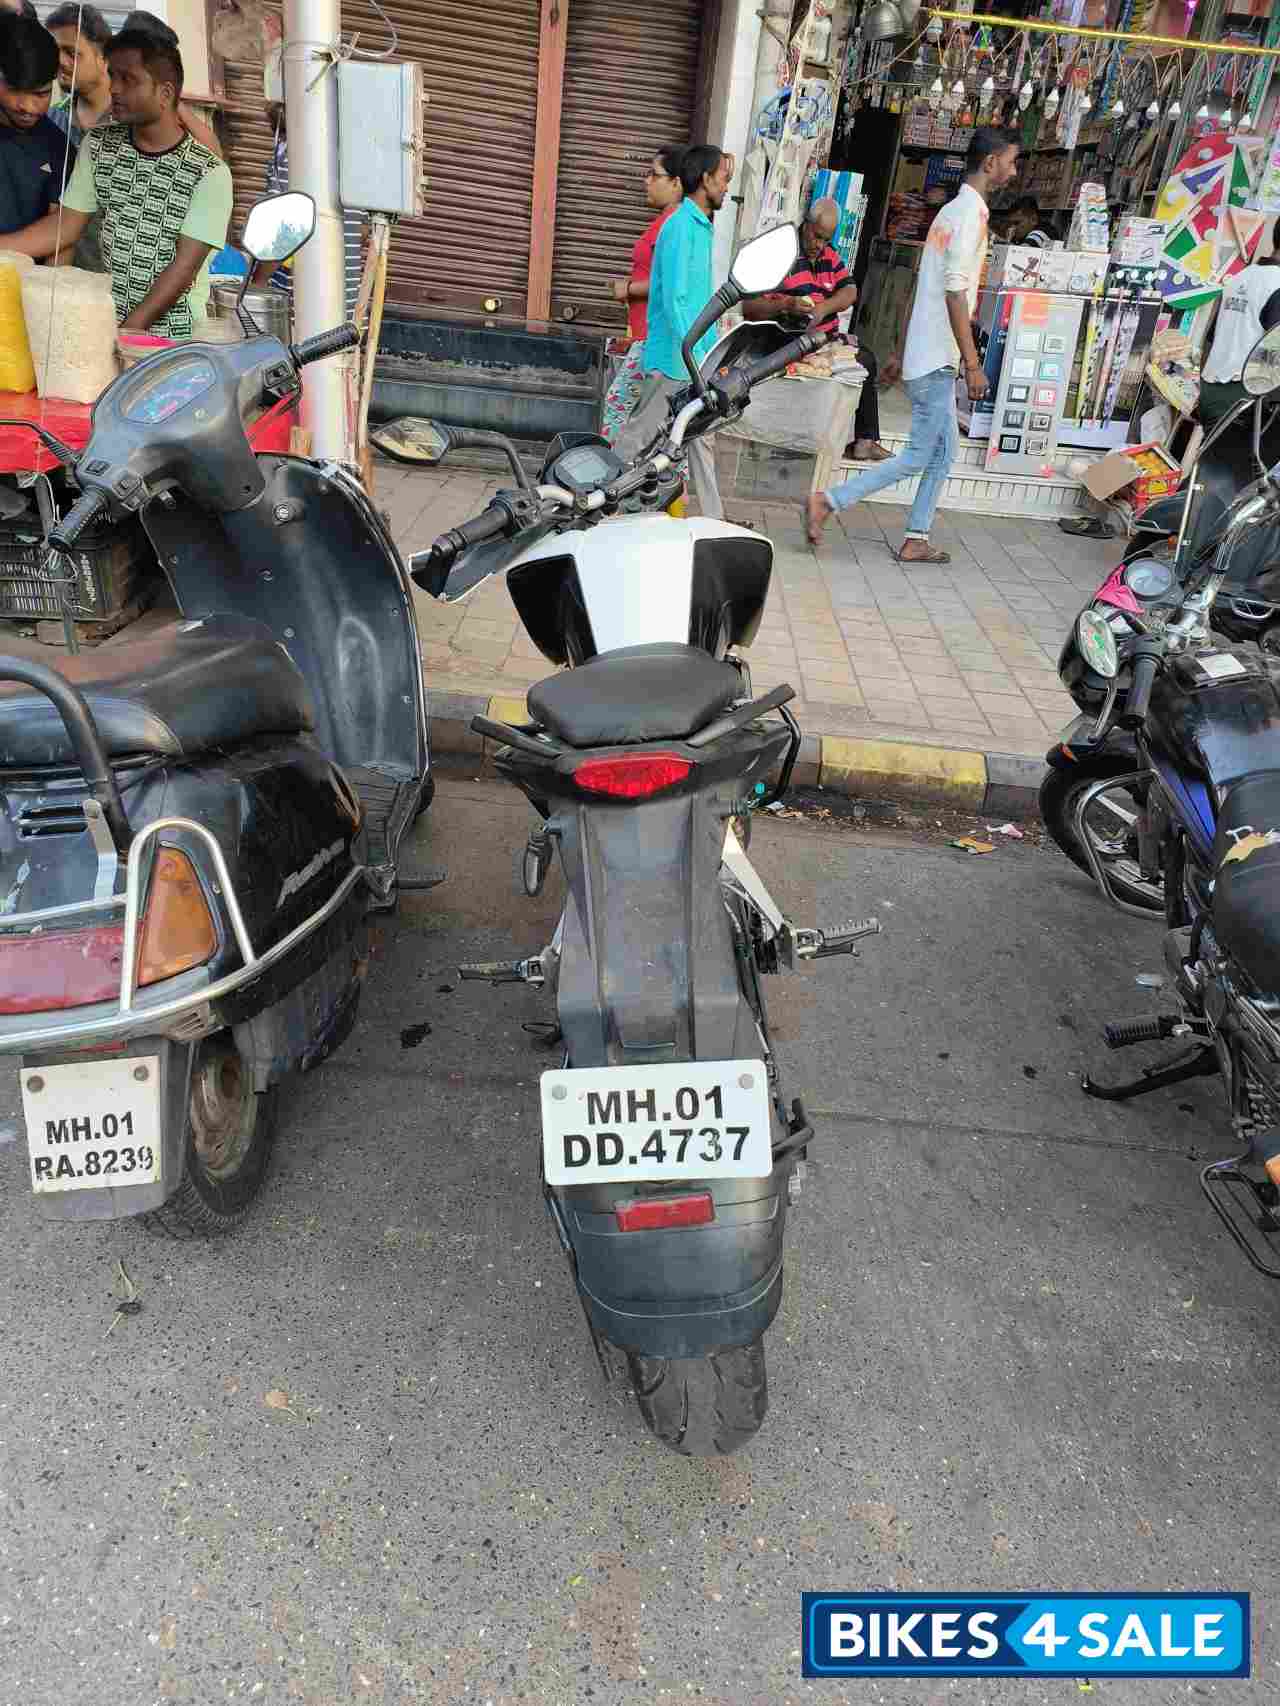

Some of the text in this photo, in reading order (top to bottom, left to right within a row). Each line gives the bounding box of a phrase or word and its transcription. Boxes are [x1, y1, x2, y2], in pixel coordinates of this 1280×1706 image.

[587, 1085, 724, 1125] MH.01
[46, 1111, 134, 1145] MH.01
[562, 1126, 751, 1168] DD.4737
